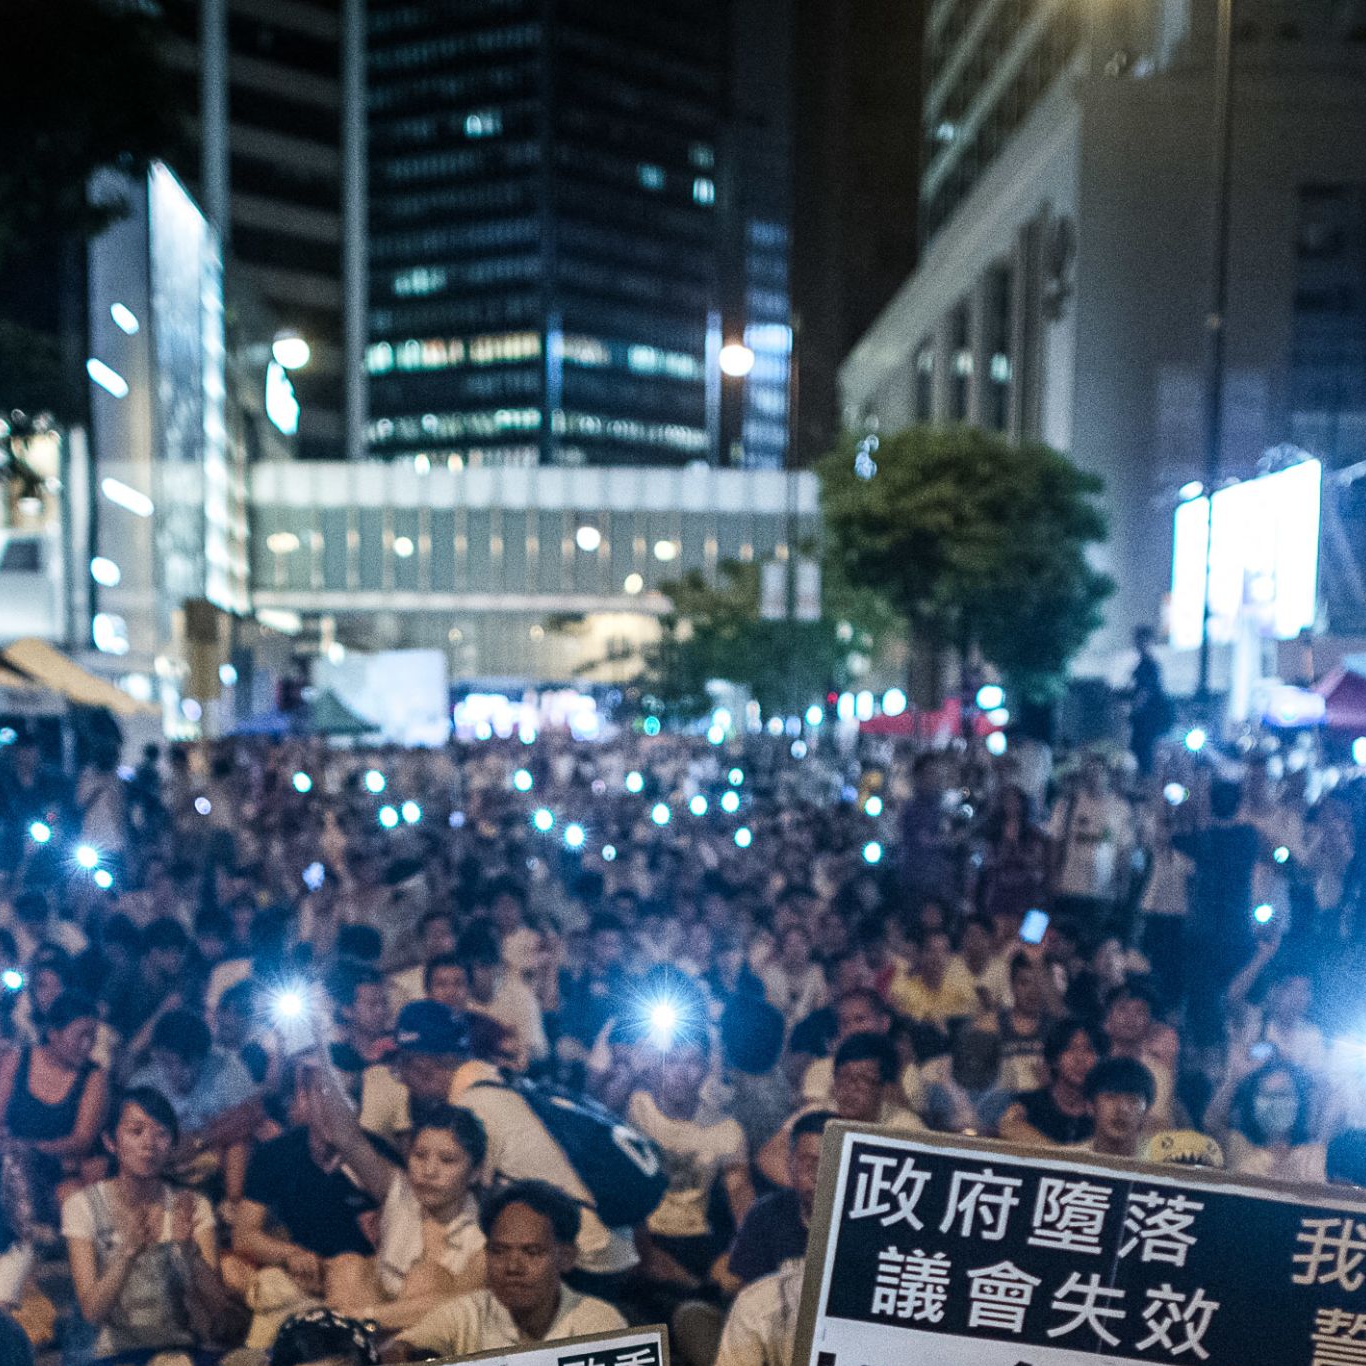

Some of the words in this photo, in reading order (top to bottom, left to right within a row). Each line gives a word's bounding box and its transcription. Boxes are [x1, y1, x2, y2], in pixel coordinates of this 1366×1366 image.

[848, 1154, 1205, 1268] 政府墮落
[870, 1245, 1221, 1361] 議會失效
